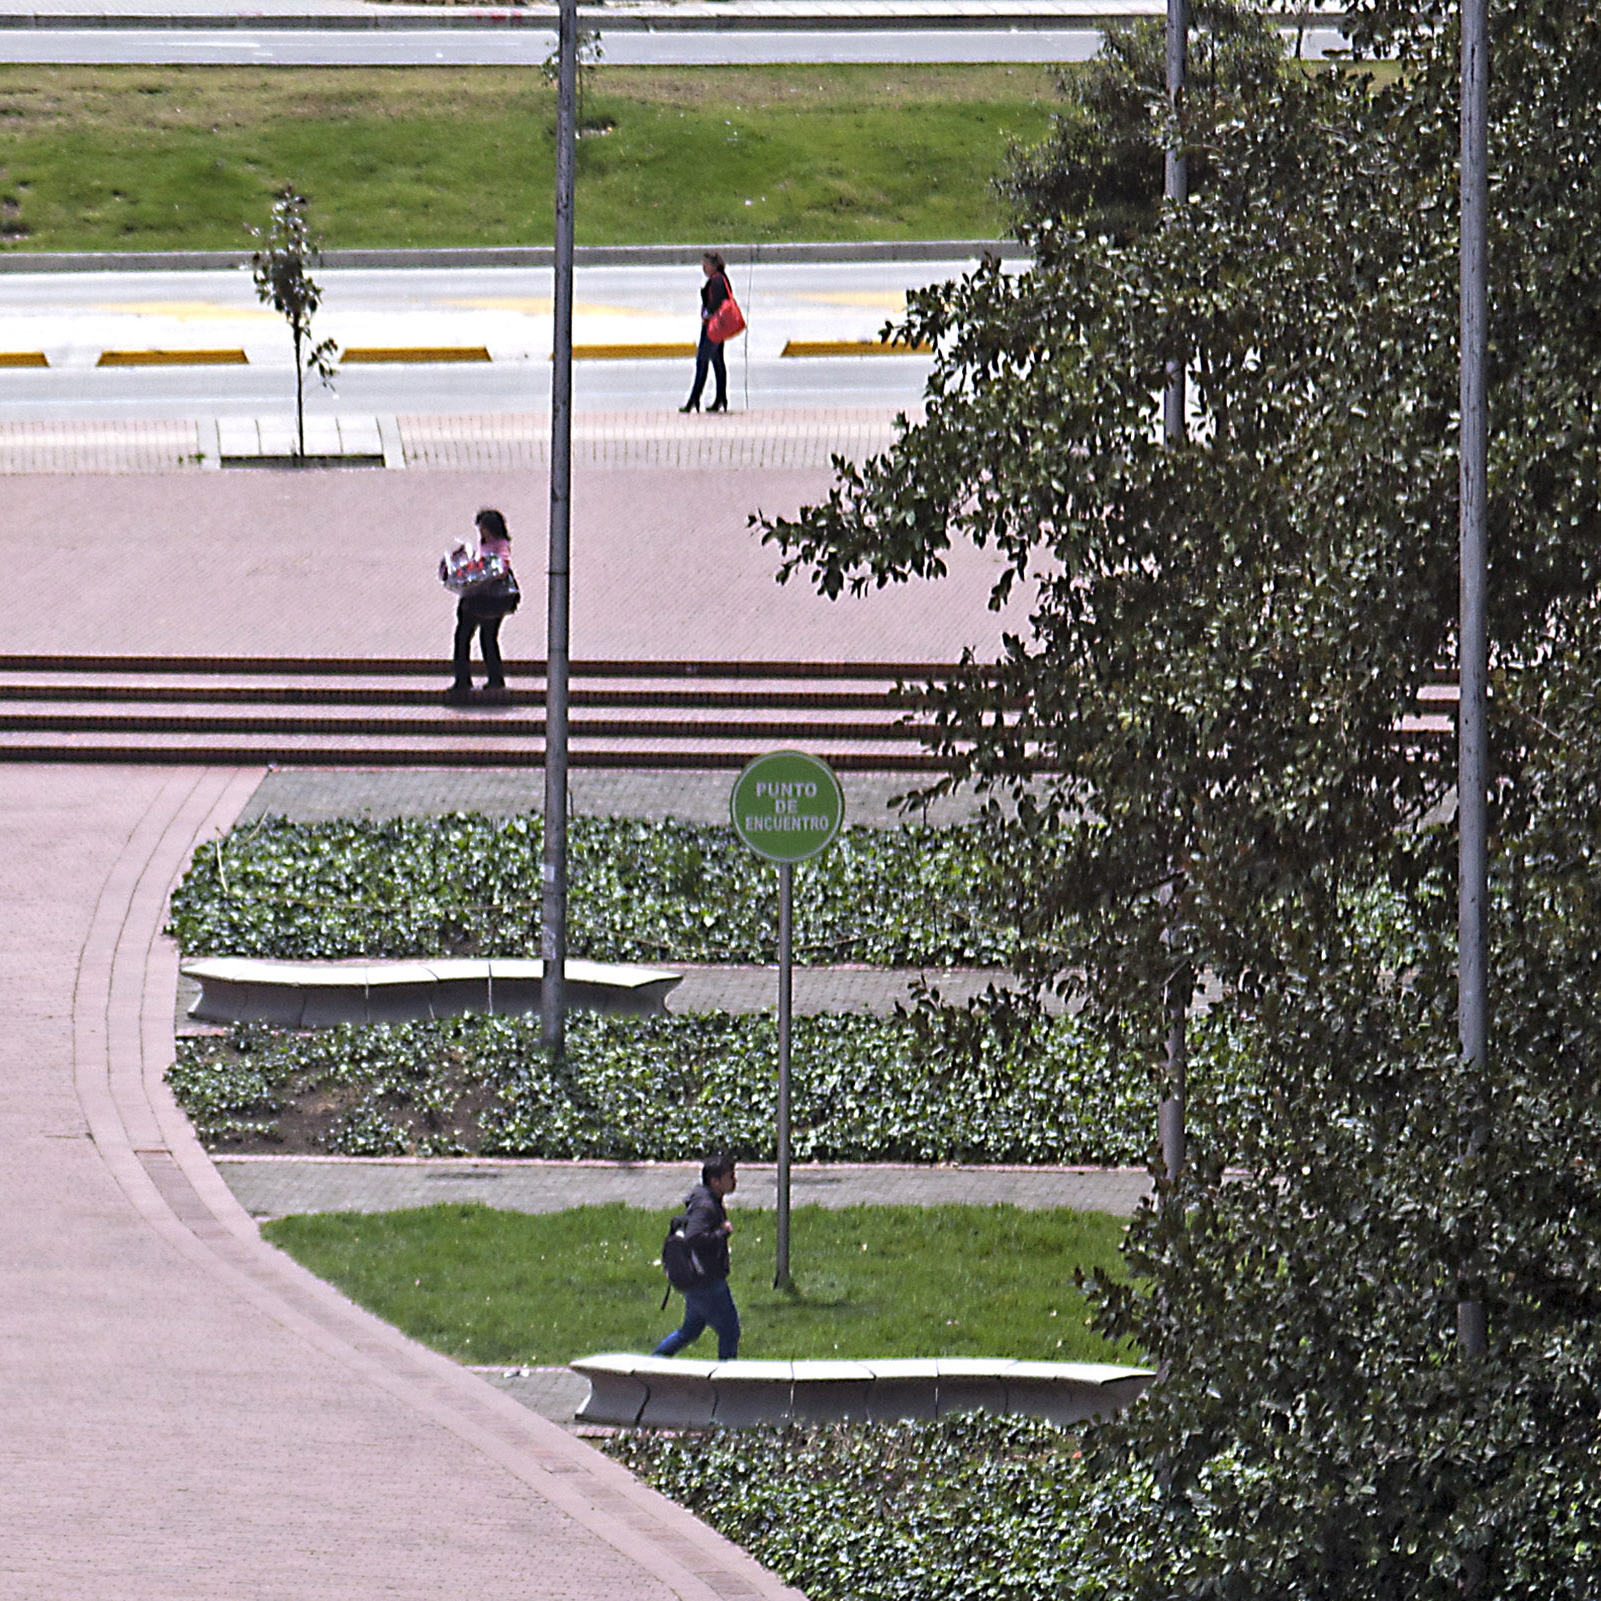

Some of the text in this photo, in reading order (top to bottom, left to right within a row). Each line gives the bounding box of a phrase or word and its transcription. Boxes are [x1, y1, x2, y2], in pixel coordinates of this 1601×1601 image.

[755, 782, 818, 797] PUNTO
[774, 799, 798, 814] DE
[745, 815, 829, 831] ENCUENTRO
